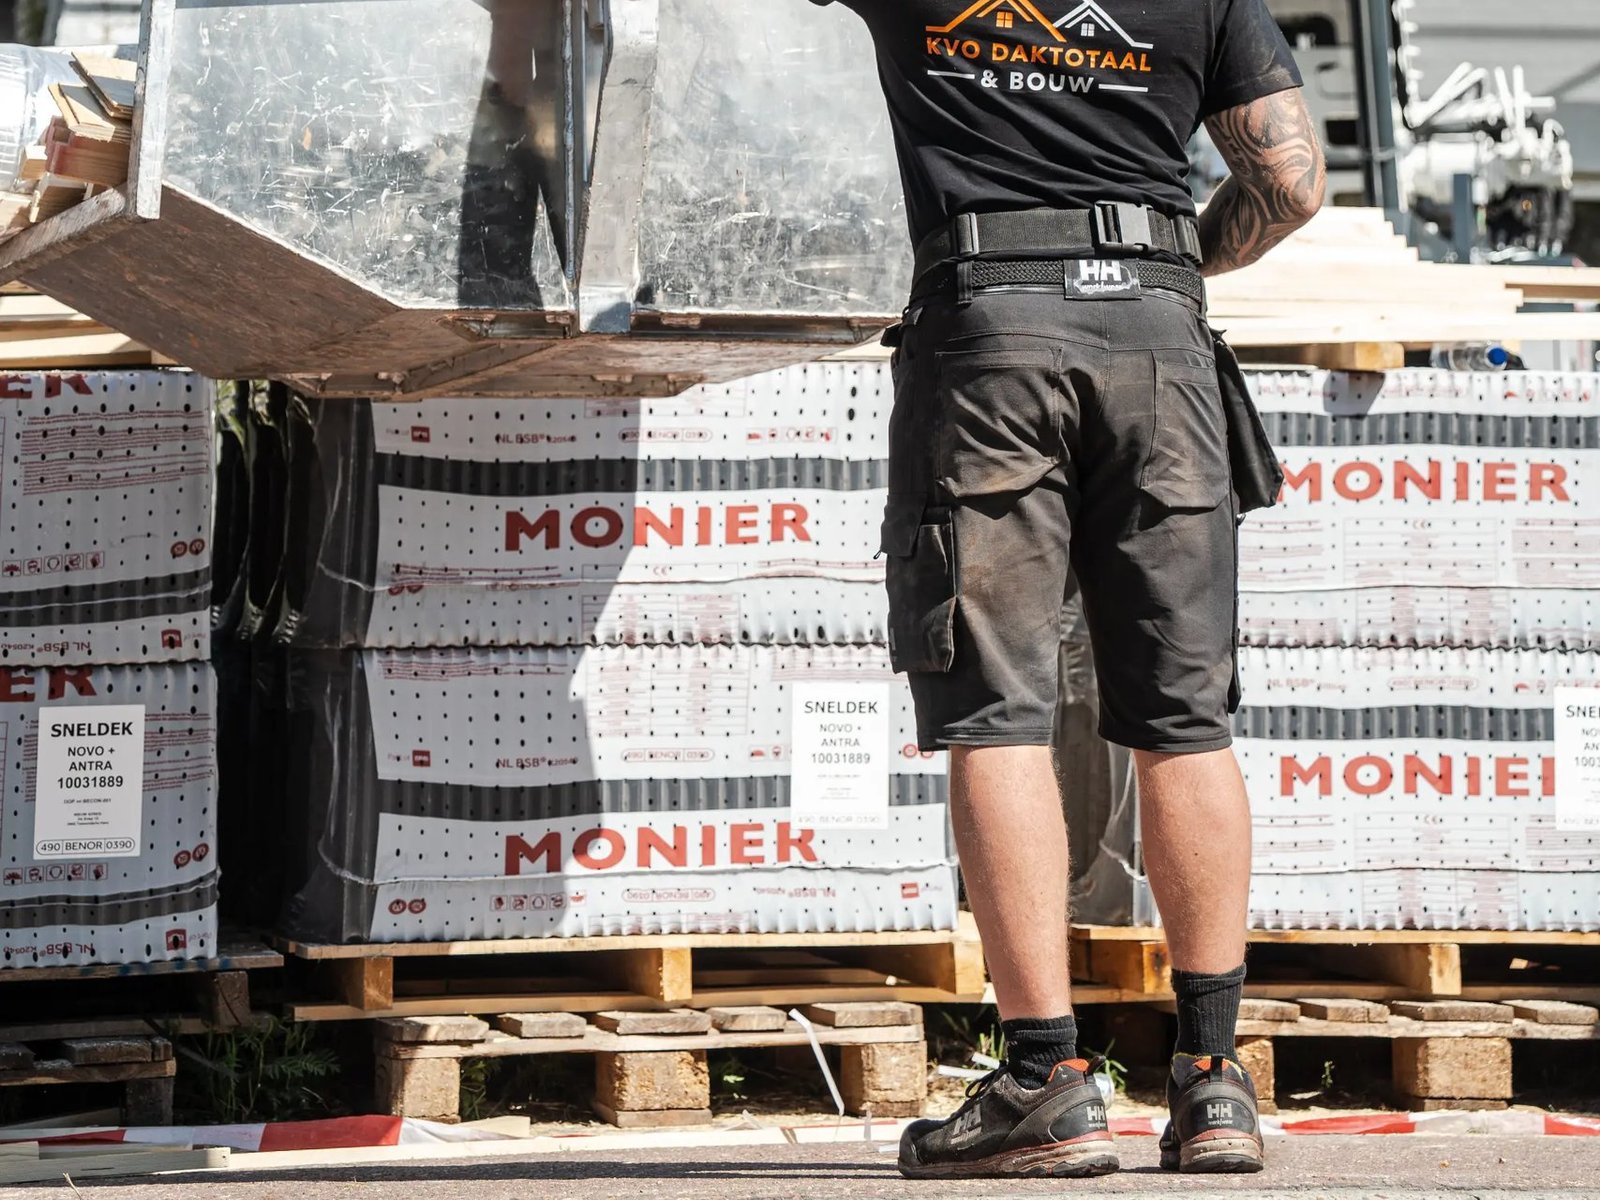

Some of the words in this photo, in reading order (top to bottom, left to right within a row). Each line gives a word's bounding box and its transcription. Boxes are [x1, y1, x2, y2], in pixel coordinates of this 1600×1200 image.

[925, 37, 981, 60] KVO
[991, 42, 1152, 72] DAKTOTAAL
[980, 69, 998, 89] &
[1009, 71, 1095, 93] BOUW
[1079, 259, 1122, 281] HH
[1275, 460, 1570, 501] MONIER
[505, 503, 812, 551] MONIER
[804, 701, 879, 714] SNELDEK
[1566, 705, 1600, 718] SNE
[50, 722, 134, 738] SNELDEK
[819, 723, 853, 733] NOVO
[821, 737, 860, 748] ANTRA
[67, 745, 105, 757] NOVO
[108, 747, 116, 755] +
[812, 753, 871, 764] 10031889
[68, 760, 113, 772] ANTRA
[57, 775, 124, 790] 10031889
[40, 842, 61, 852] 490
[65, 840, 103, 851] BENOR
[106, 840, 132, 850] 0390
[505, 822, 820, 876] MONIER
[1086, 1105, 1106, 1121] HH
[1207, 1103, 1232, 1118] HH
